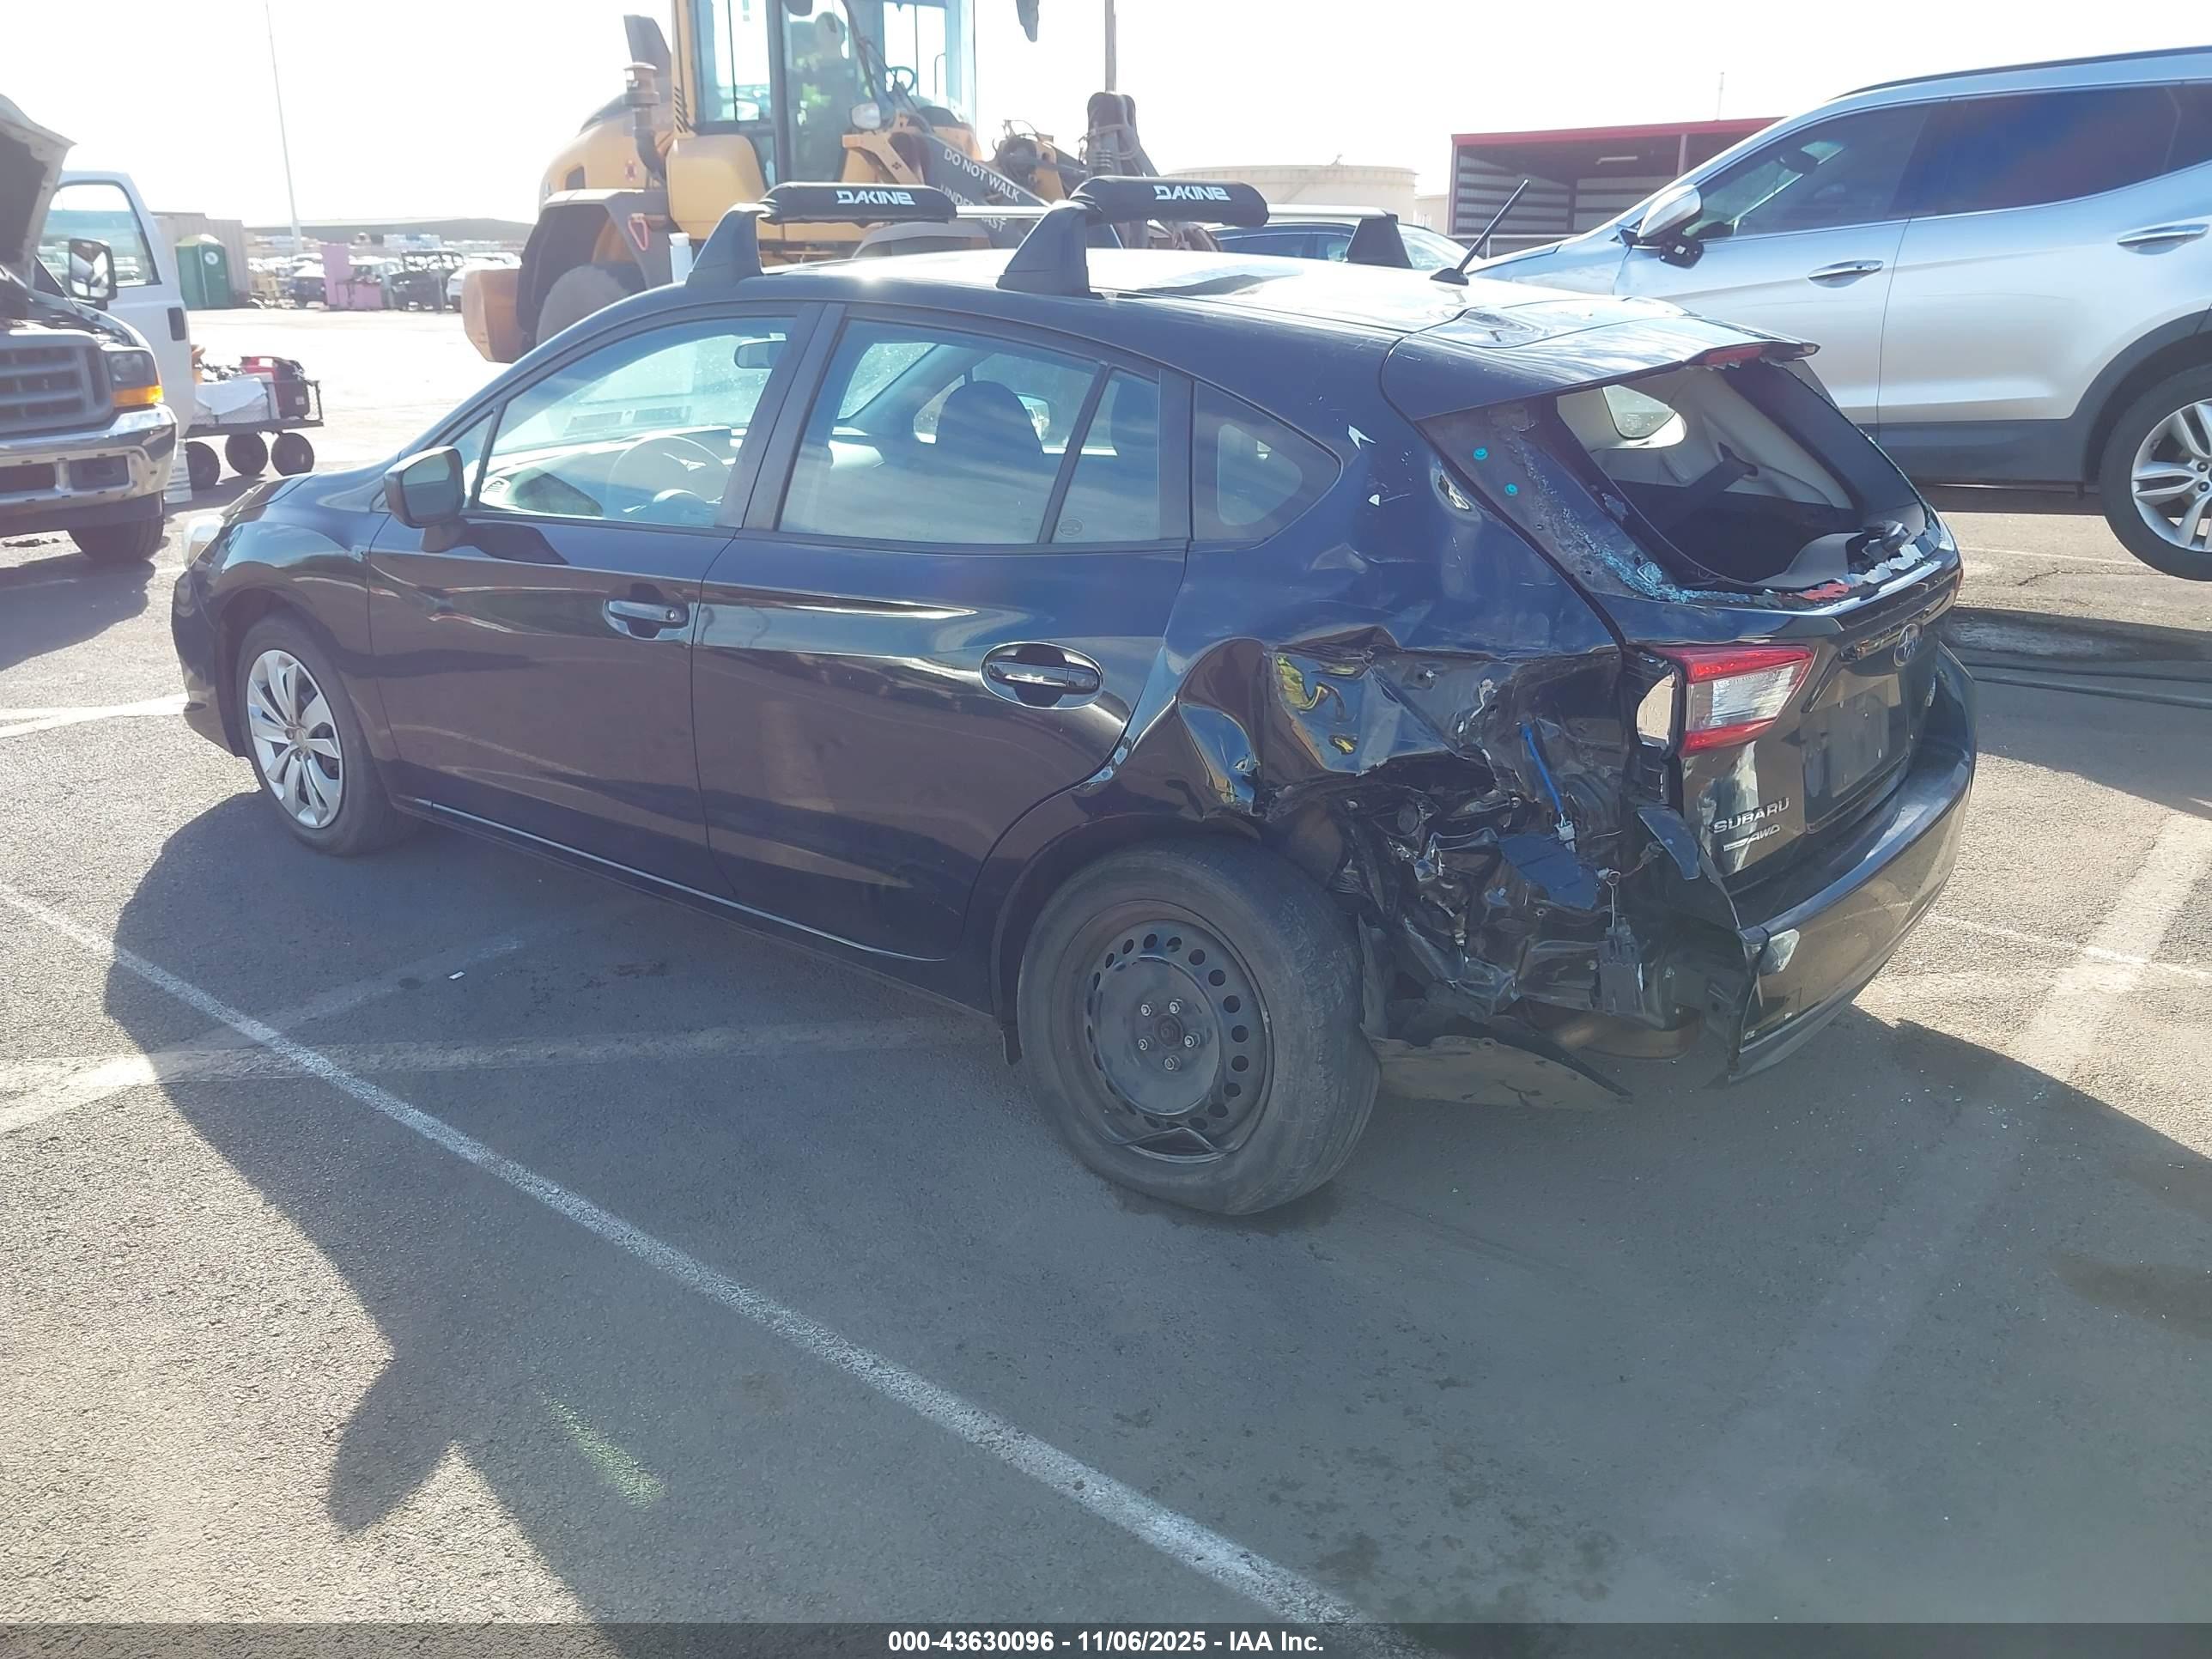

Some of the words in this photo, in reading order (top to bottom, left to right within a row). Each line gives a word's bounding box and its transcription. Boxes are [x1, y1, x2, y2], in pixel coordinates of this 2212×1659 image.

[944, 148, 962, 166] DO
[962, 159, 987, 181] NOT
[988, 173, 1019, 203] WALK
[836, 190, 916, 205] DAKINE
[1152, 185, 1231, 201] DAKINE
[981, 216, 1006, 232] AST
[1713, 797, 1790, 834] SUBARU
[1747, 823, 1781, 845] AWD
